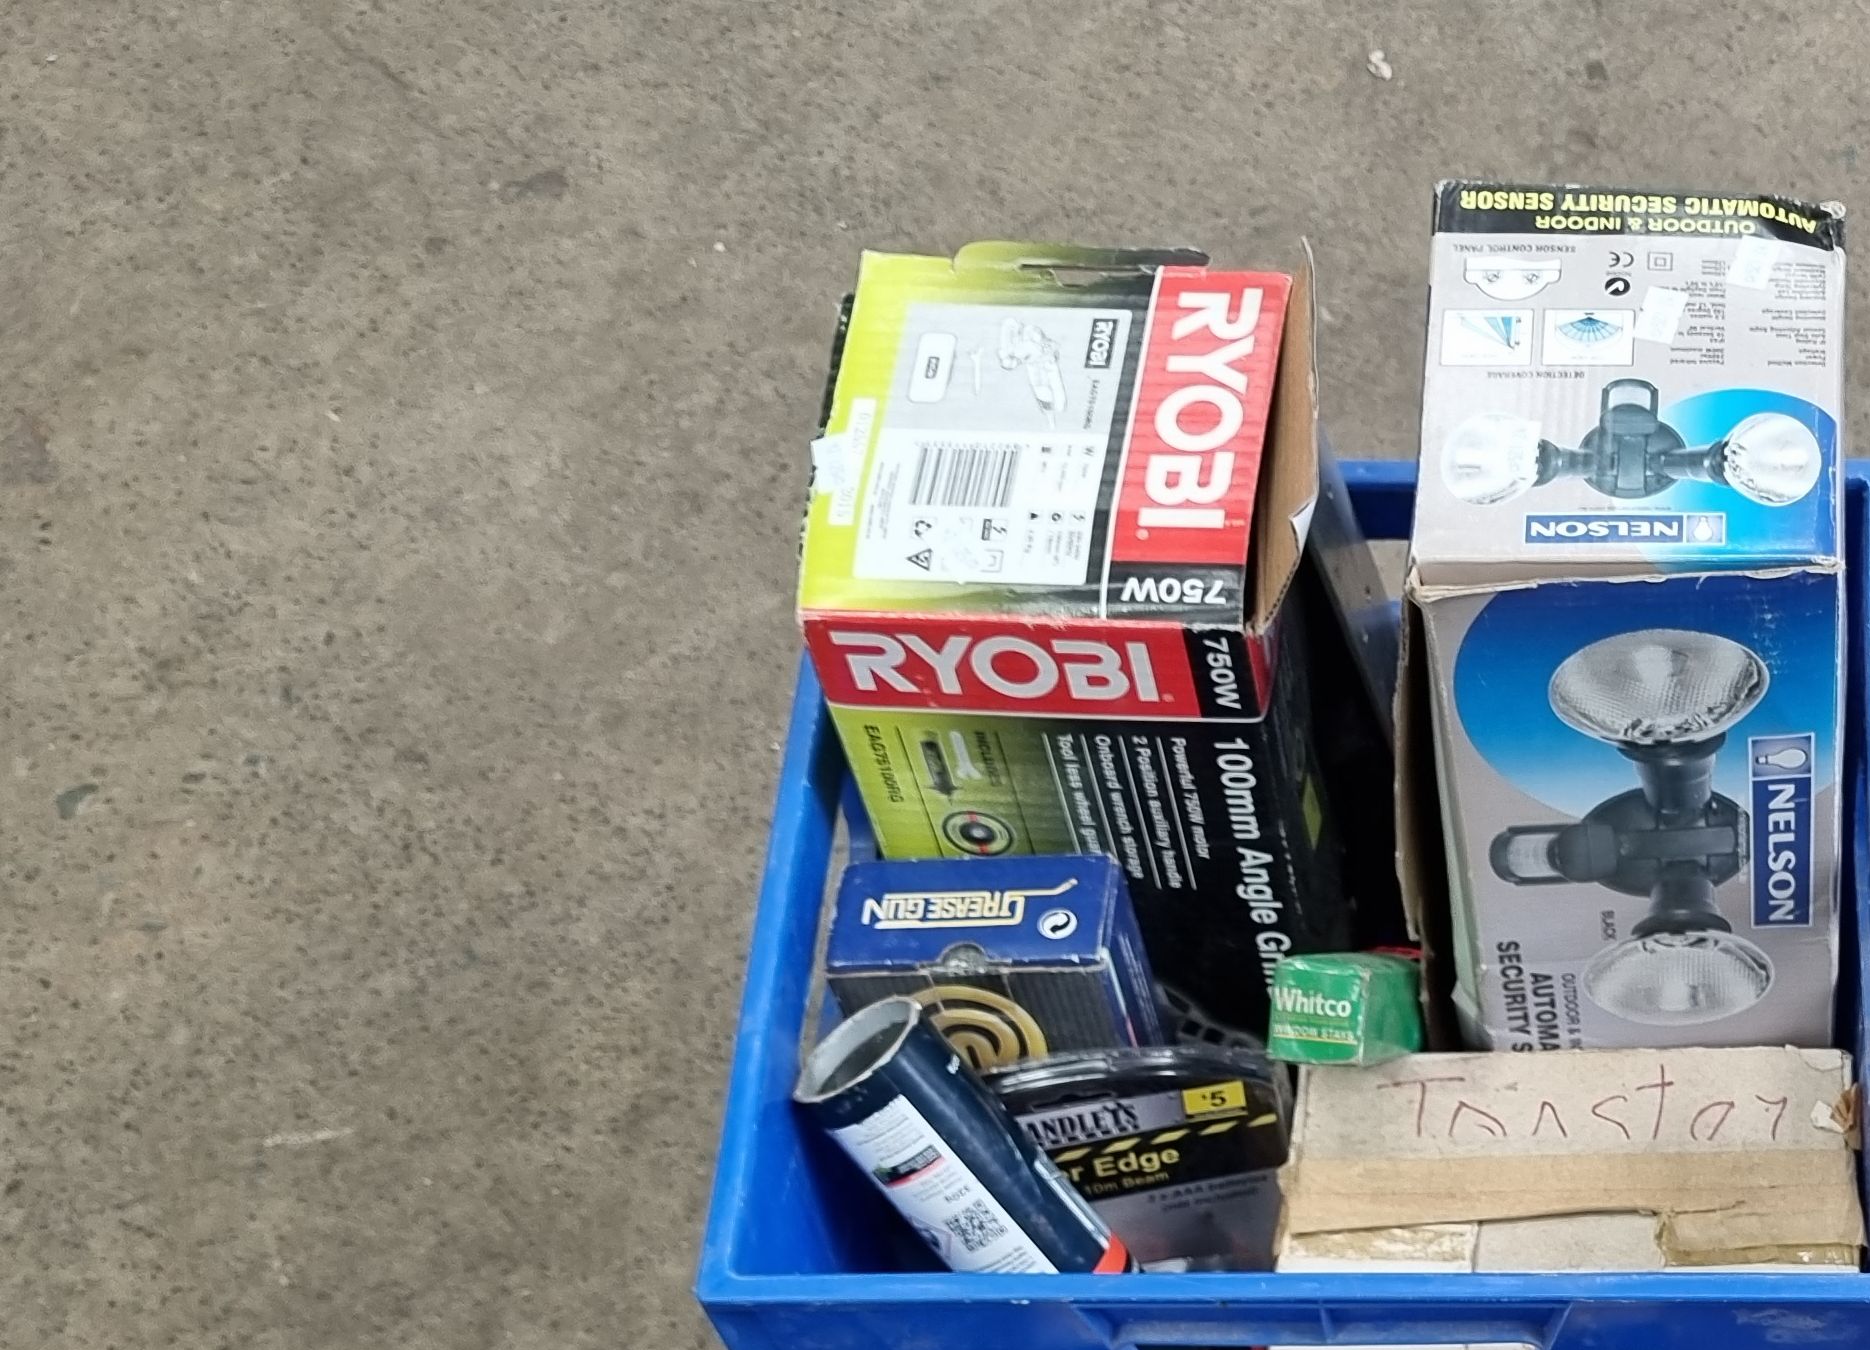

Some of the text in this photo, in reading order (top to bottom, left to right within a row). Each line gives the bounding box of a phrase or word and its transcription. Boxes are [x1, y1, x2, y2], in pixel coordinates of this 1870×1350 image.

[1460, 190, 1818, 234] AUTOMATIC SECURITY SENSOR
[1534, 214, 1756, 234] OUTDOOR & INDOOR
[1089, 320, 1115, 368] RYOBI
[1137, 287, 1263, 529] RYOBI
[1529, 519, 1679, 538] NELSON
[1120, 576, 1228, 606] 750W
[827, 630, 1161, 702] RYOBI
[1202, 636, 1242, 710] 750W
[1057, 734, 1077, 760] Tool
[1065, 762, 1084, 788] less
[1171, 738, 1210, 858] Powerful 750W motor
[1073, 791, 1096, 826] wheel
[1094, 737, 1144, 878] Onboard wrench storage
[1131, 736, 1181, 888] 2 Position auxiliary handle
[1212, 735, 1261, 841] 100mm
[1237, 846, 1279, 926] Angle
[1767, 783, 1796, 922] NELSON
[861, 891, 1026, 929] GREASE GUN
[1601, 909, 1616, 942] BLACK
[1273, 985, 1352, 1018] Whitco
[1495, 941, 1527, 1041] SECURITY
[1560, 973, 1577, 1026] OUTDOOR
[1095, 1147, 1181, 1180] Edge
